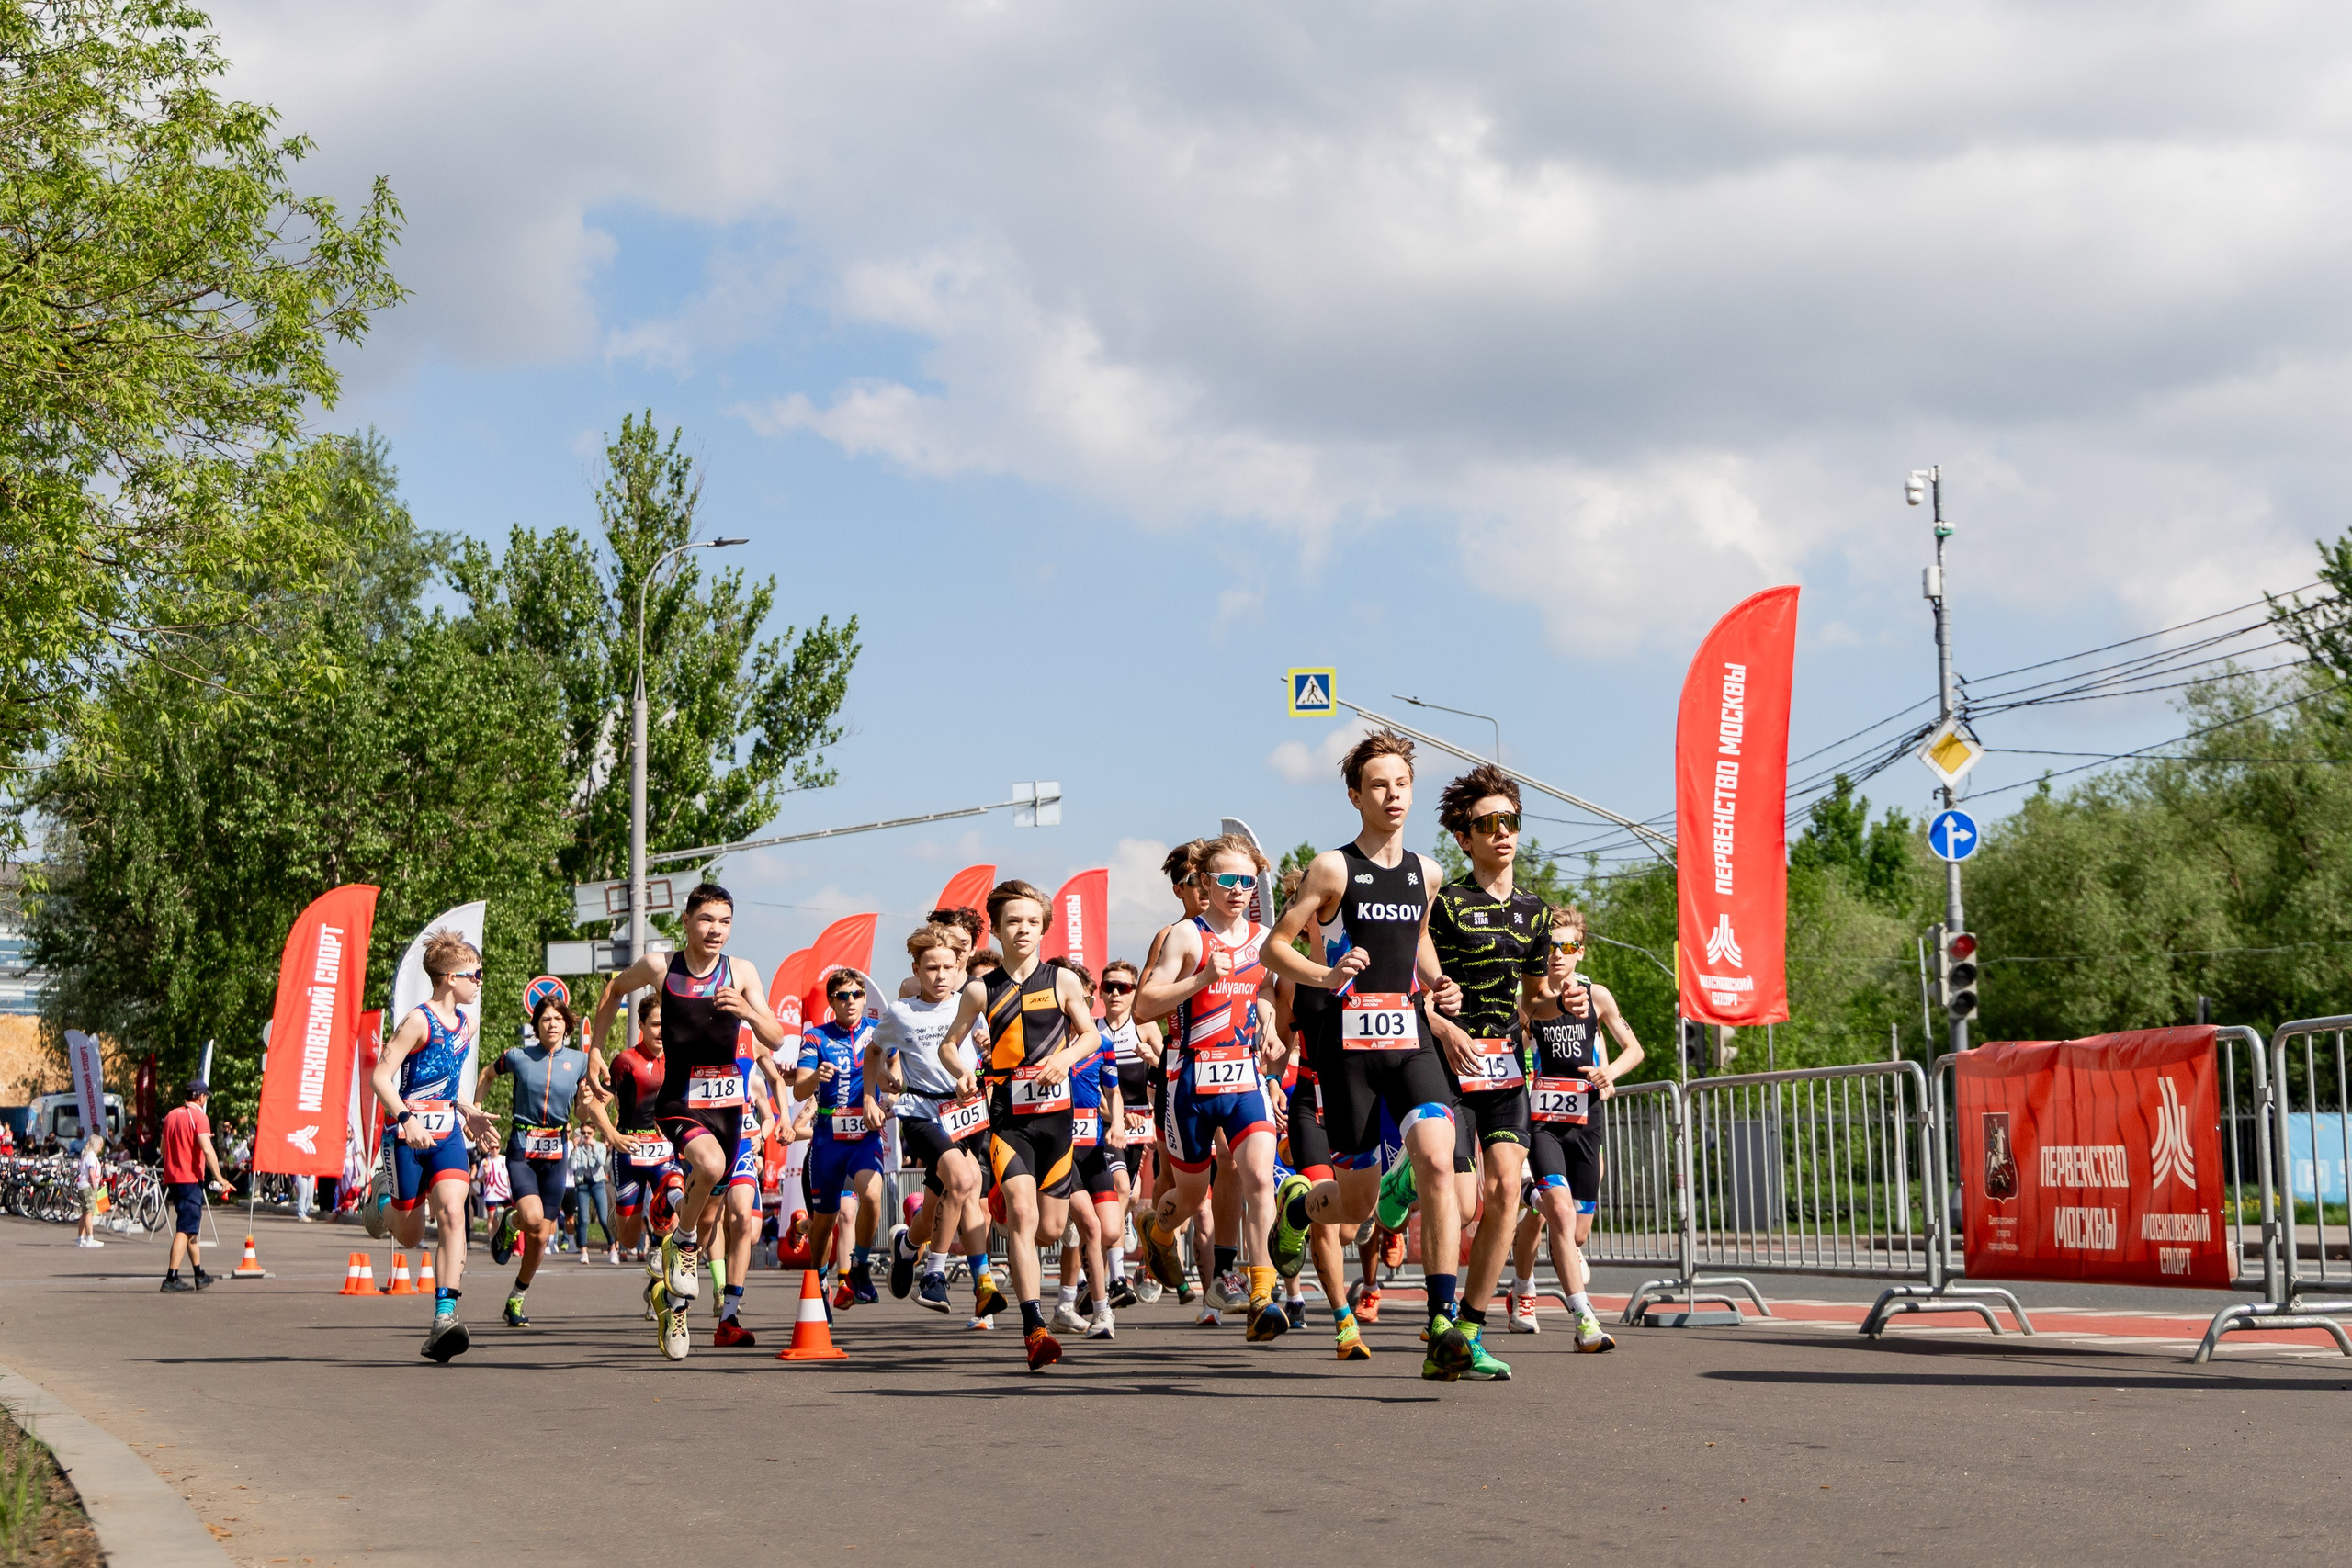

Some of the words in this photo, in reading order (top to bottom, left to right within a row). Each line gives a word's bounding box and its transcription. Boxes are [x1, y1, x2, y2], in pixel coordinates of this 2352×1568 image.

[1718, 662, 1747, 757] МОСКВЫ
[1713, 761, 1739, 896] ПЕРВЕНСТВО
[1357, 902, 1422, 921] KOSOV
[1474, 917, 1488, 925] STAR
[1066, 895, 1083, 950] МОСКВЫ
[314, 922, 344, 984] СПОРТ
[1208, 977, 1256, 998] Lukyanov
[1699, 973, 1754, 993] МОСКОВСКИЙ
[1711, 991, 1738, 1008] СПОРТ
[1359, 1012, 1405, 1036] 103
[1543, 1023, 1587, 1043] ROGOZHIN
[298, 986, 336, 1112] МОСКОВСКИЙ
[1552, 1041, 1582, 1058] RUS
[1208, 1062, 1245, 1083] 127
[701, 1079, 735, 1099] 118
[1023, 1082, 1062, 1101] 140
[1539, 1093, 1577, 1113] 128
[413, 1113, 445, 1130] 17
[840, 1118, 866, 1132] 136
[950, 1105, 980, 1130] 105
[534, 1139, 559, 1151] 133
[639, 1144, 666, 1157] 122
[383, 1141, 395, 1195] AQUATICS
[2040, 1145, 2130, 1189] ПЕРВЕНСТВО
[2053, 1206, 2118, 1250] МОСКВЫ
[2141, 1208, 2211, 1243] МОСКОВСКИЙ
[2159, 1247, 2192, 1276] СПОРТ
